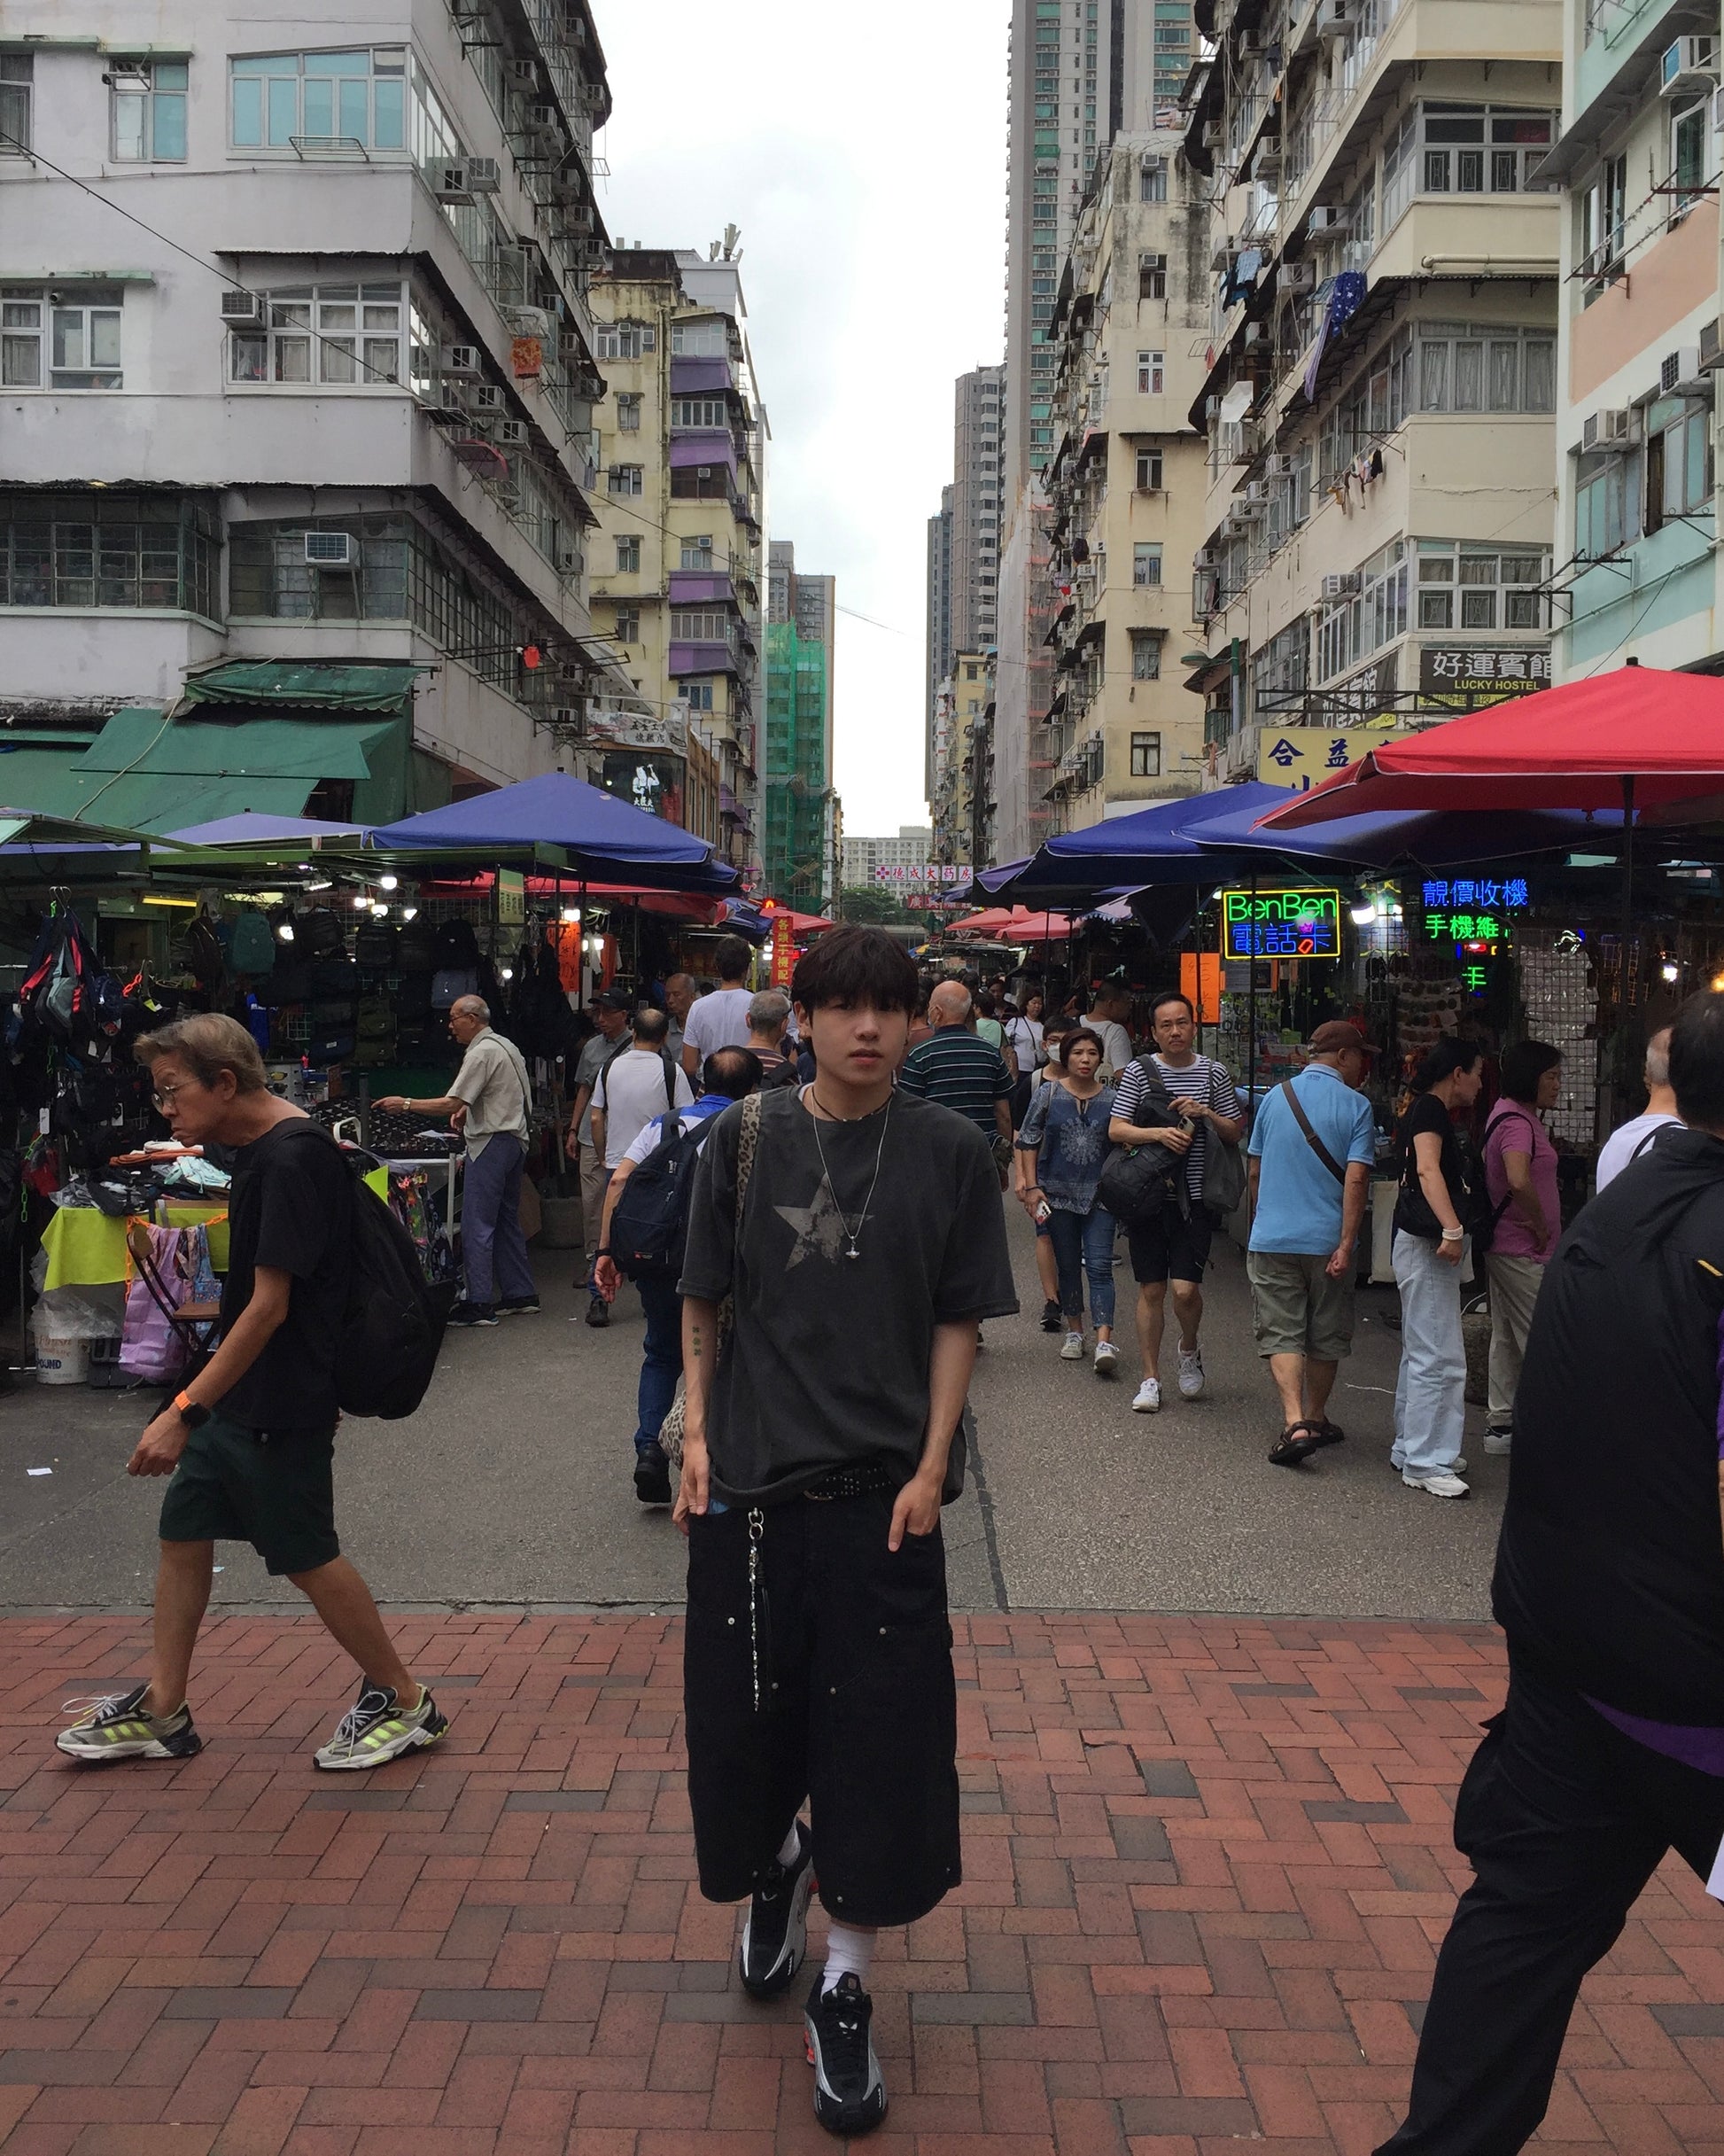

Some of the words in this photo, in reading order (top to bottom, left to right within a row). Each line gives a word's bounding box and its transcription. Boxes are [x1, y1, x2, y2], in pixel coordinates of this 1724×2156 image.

[1433, 651, 1551, 680] 好運賓館
[1454, 680, 1493, 689] LUCKY
[1495, 680, 1540, 690] HOSTEL
[1268, 737, 1393, 767] 合益
[1228, 893, 1336, 921] BenBen
[1423, 879, 1528, 907] 靚價收機
[1231, 922, 1332, 954] 電話卡
[1425, 914, 1509, 939] 手機維
[777, 918, 789, 985] 各類手機配
